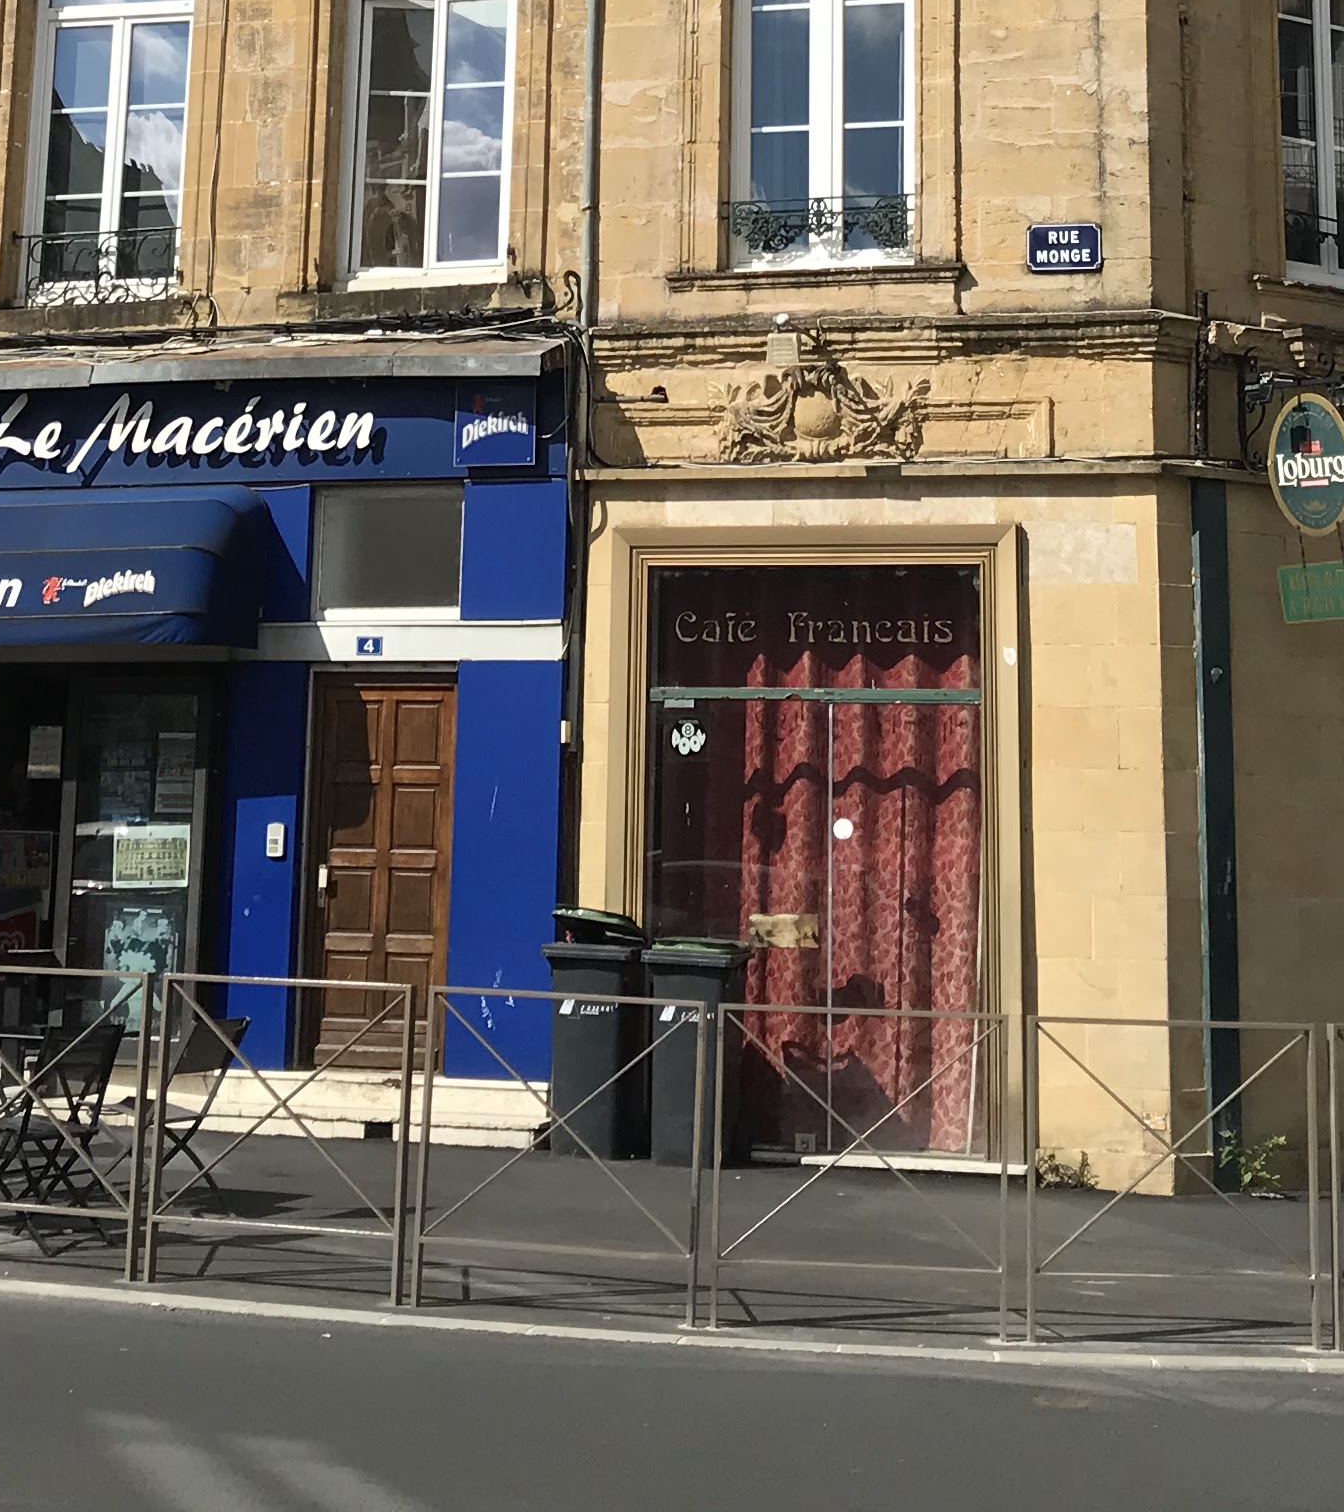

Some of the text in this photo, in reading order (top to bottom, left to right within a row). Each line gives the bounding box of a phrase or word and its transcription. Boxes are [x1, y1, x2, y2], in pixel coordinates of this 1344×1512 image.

[1048, 230, 1080, 244] RUE
[1036, 248, 1091, 264] MONGE
[66, 392, 375, 474] Macérien
[461, 410, 529, 450] Diekirch
[83, 569, 155, 608] Diekirch
[787, 610, 953, 643] Francais
[363, 639, 375, 654] 4
